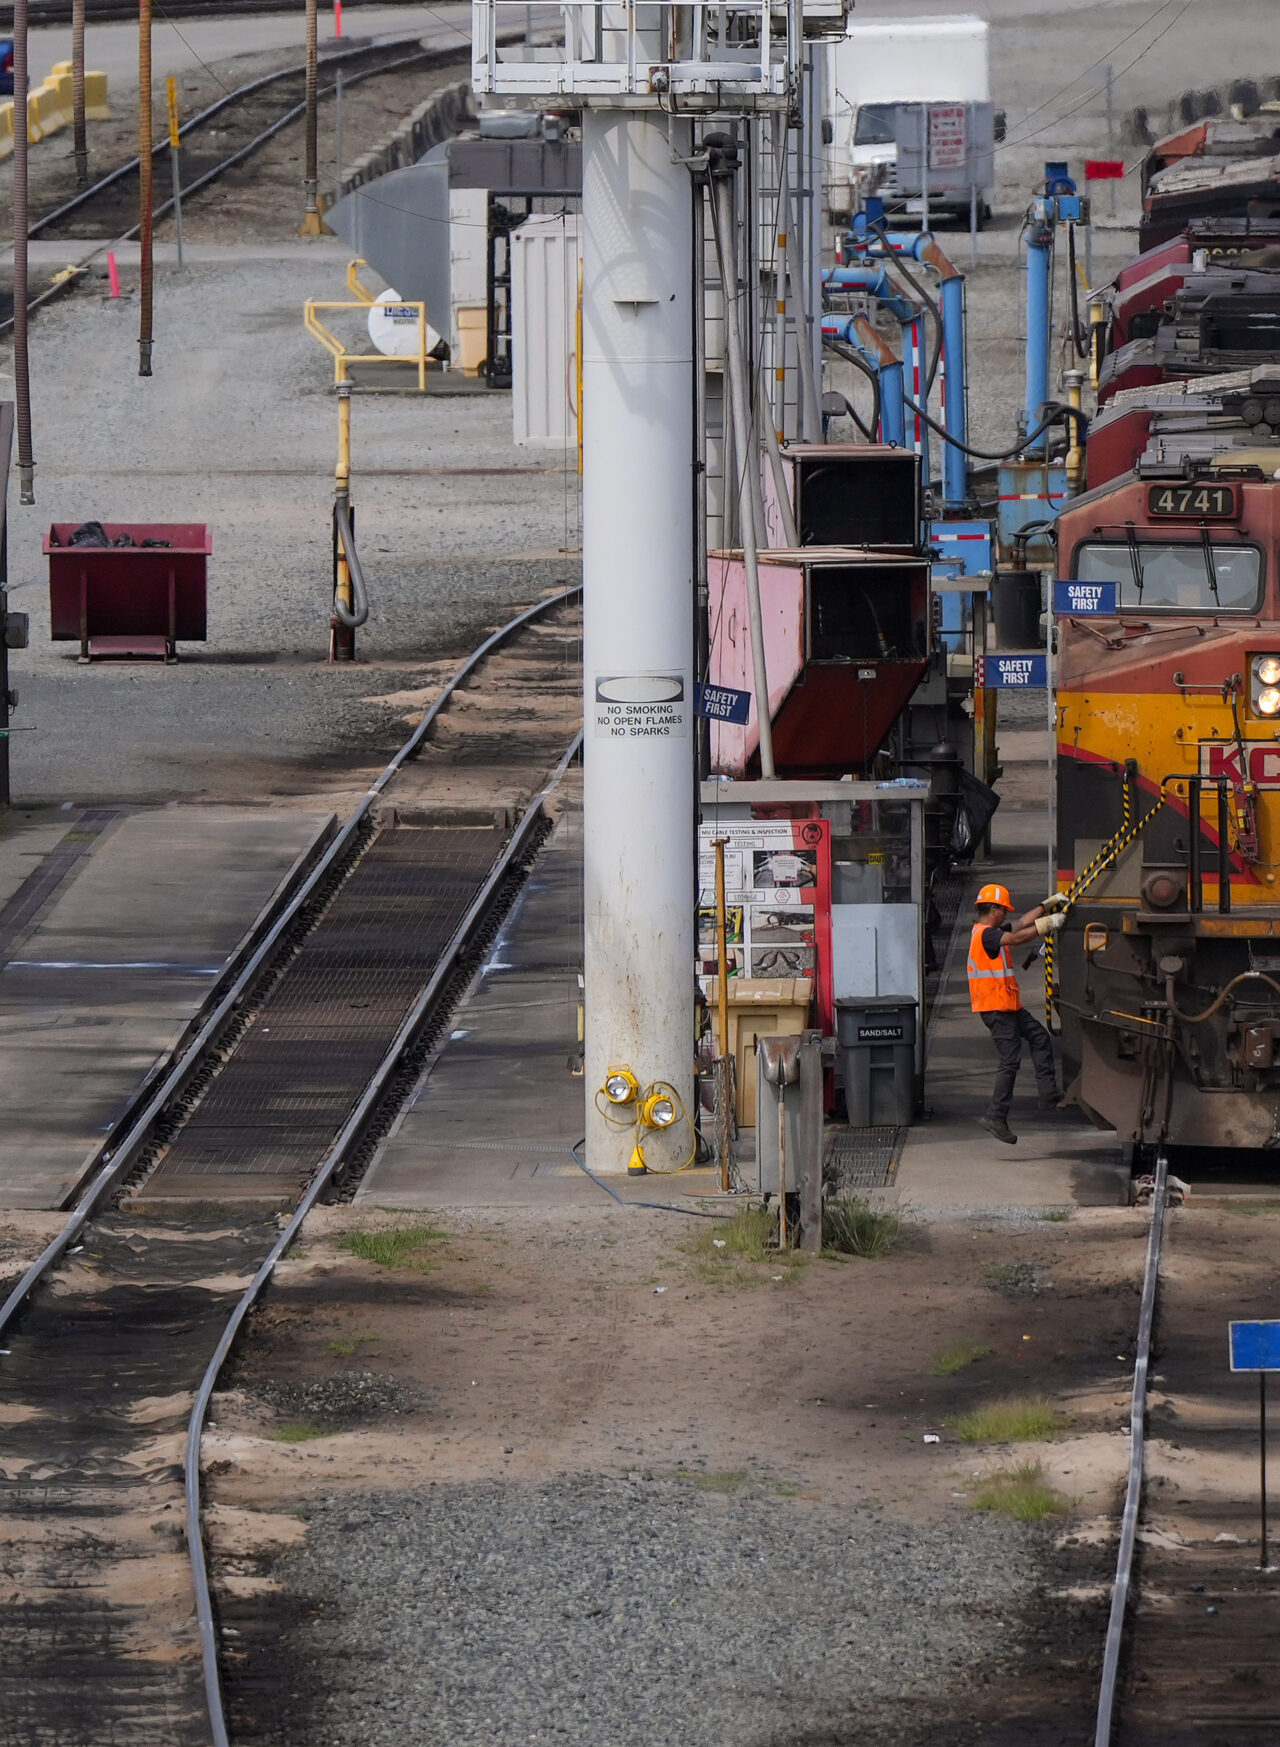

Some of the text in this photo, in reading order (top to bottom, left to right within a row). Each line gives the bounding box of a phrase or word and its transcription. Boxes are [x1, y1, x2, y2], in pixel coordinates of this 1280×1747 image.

[1158, 489, 1223, 512] 4741
[1068, 585, 1103, 598] SAFETY
[1072, 598, 1099, 610] FIRST
[998, 660, 1033, 672] SAFETY
[1002, 672, 1029, 684] FIRST
[703, 689, 739, 706] SAFETY
[607, 705, 673, 715] NO SMOKING
[705, 701, 732, 717] FIRST
[597, 715, 683, 726] NO OPEN FLAMES
[611, 726, 670, 736] NO SPARKS
[859, 1028, 902, 1037] SAND/SALT
